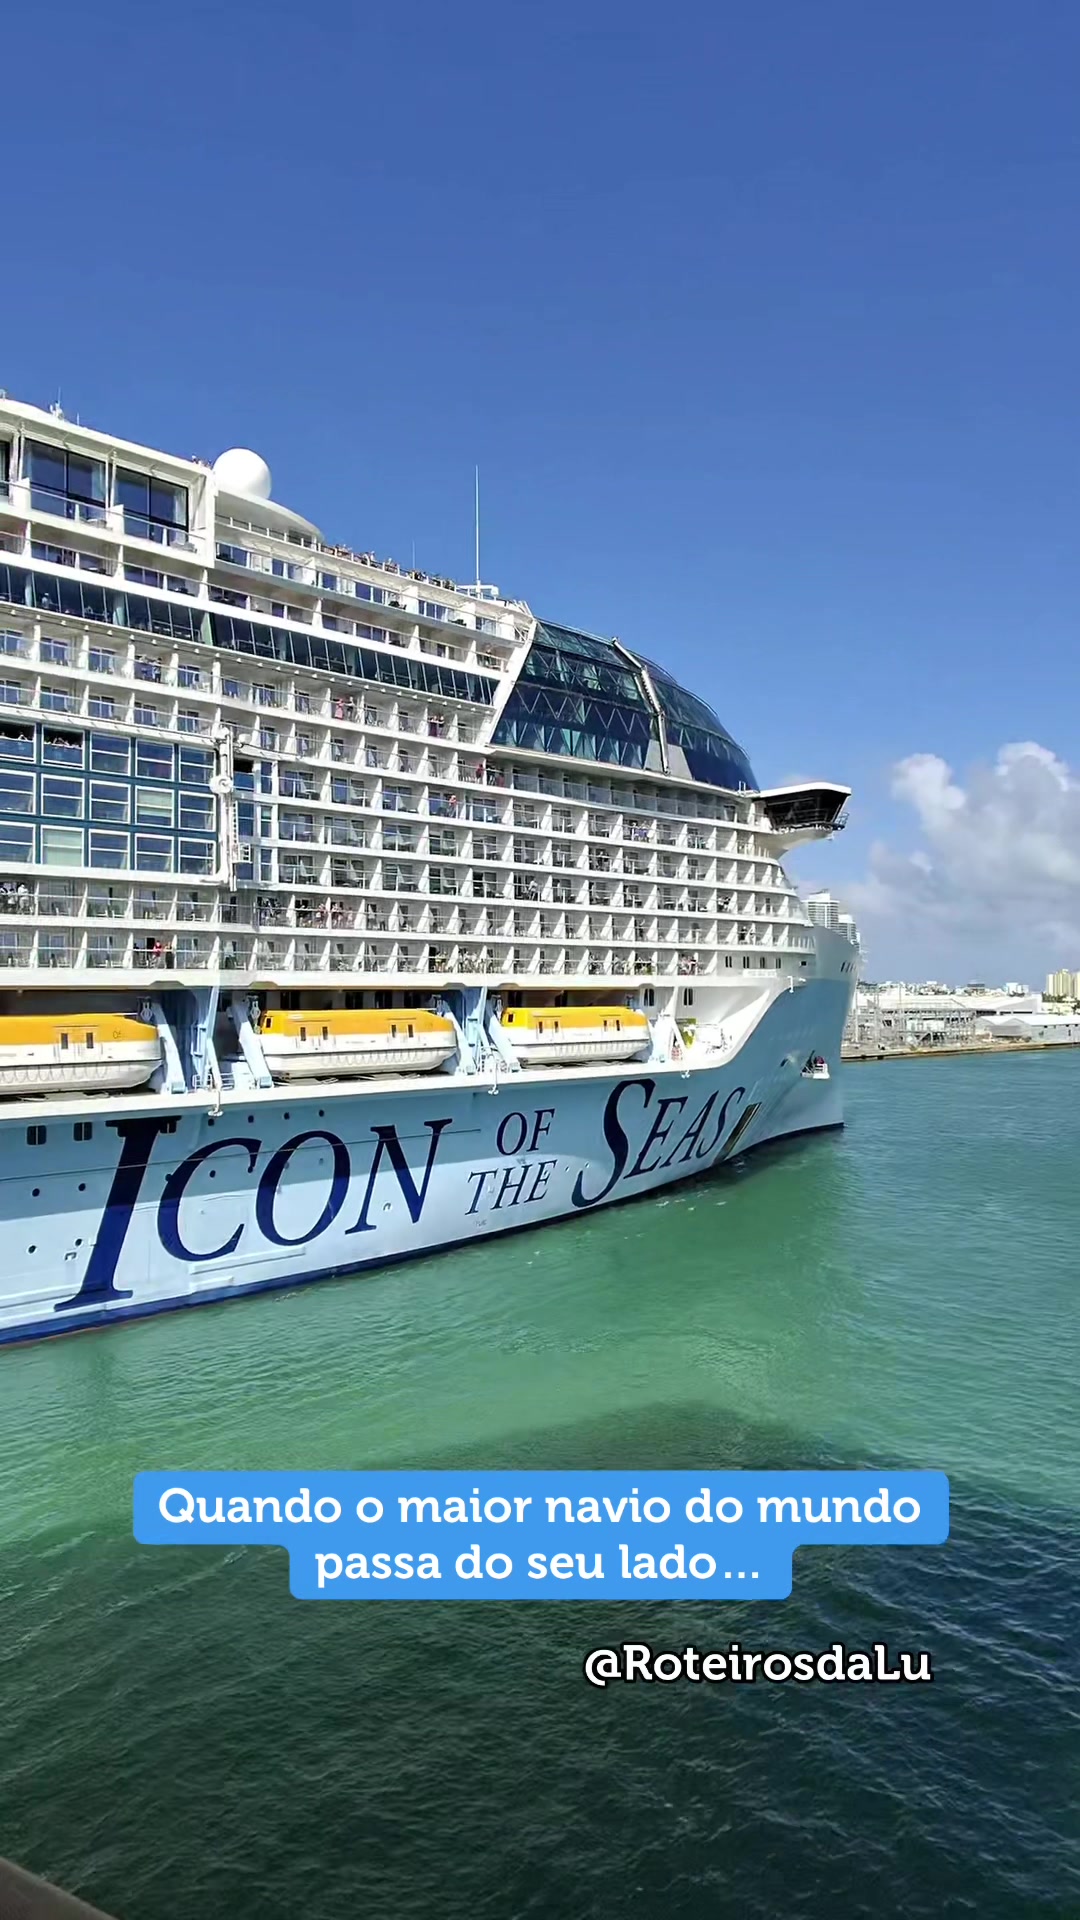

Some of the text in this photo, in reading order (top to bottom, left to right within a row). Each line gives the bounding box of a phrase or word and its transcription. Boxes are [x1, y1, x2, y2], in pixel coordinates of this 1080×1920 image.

[54, 1078, 746, 1312] ICON OF THE SEAS
